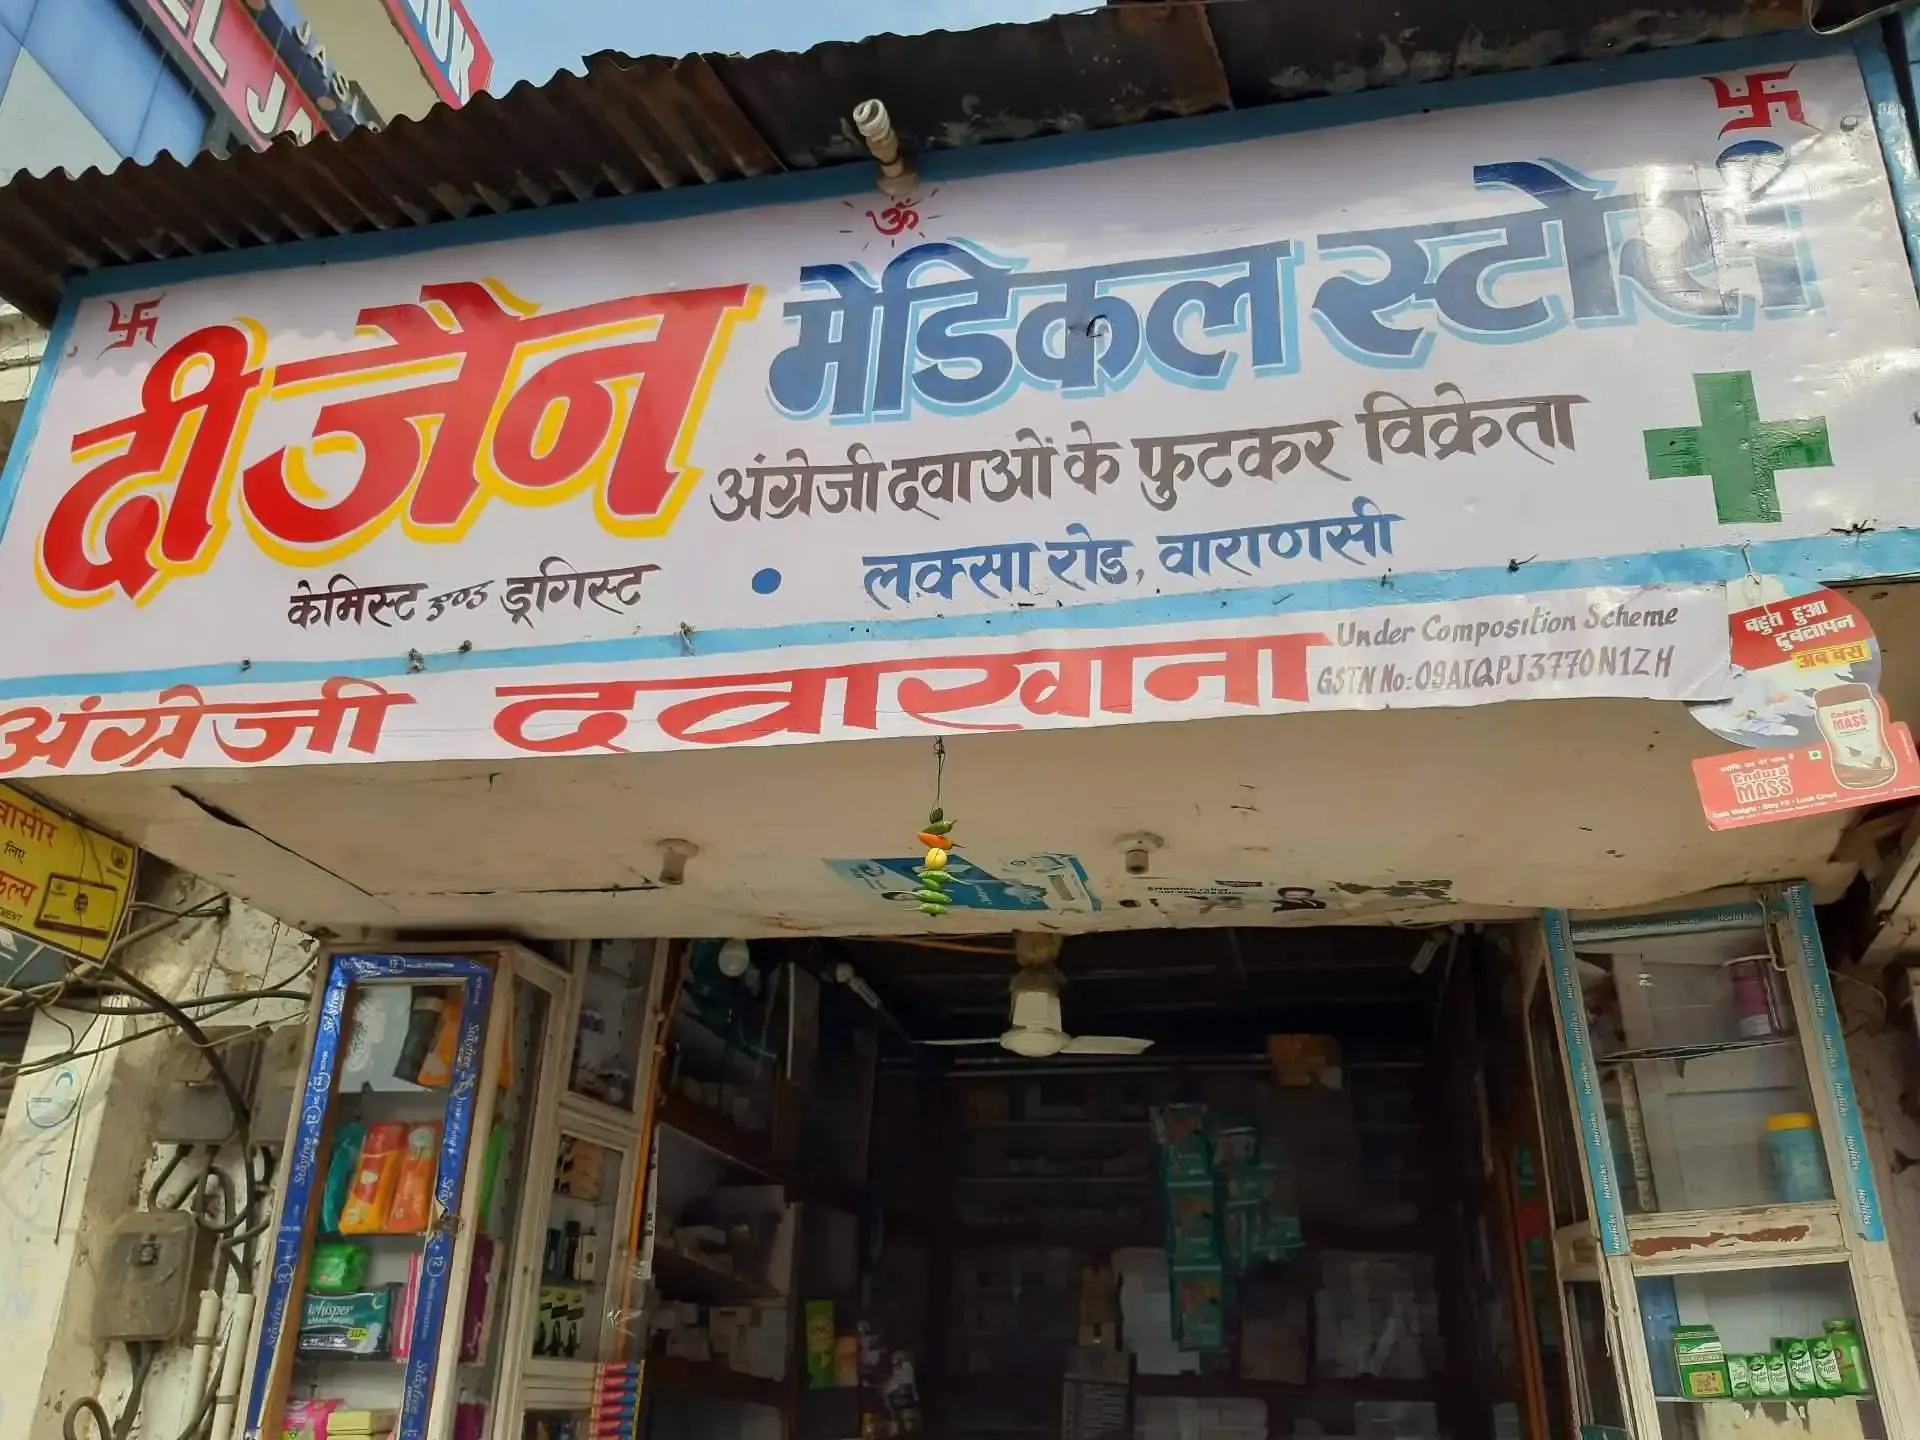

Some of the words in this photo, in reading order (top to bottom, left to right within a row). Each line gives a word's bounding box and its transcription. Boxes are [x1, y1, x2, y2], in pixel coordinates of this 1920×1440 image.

[402, 0, 475, 106] UK
[35, 316, 269, 608] दी
[242, 277, 765, 568] जैन
[767, 236, 1303, 426] मेडिकल
[710, 442, 887, 522] अंग्रेजी
[888, 427, 1061, 521] दवाओं
[1063, 420, 1121, 496] के
[1131, 419, 1353, 512] फुटकर
[1354, 381, 1591, 465] विक्रेता
[861, 542, 1042, 611] लक्सा
[1156, 495, 1406, 577] वाराणसी
[287, 573, 429, 630] केमिस्ट
[500, 556, 663, 630] ड्रगिस्ट
[1337, 618, 1416, 648] Under
[1421, 610, 1577, 648] Composition
[1583, 605, 1679, 630] Scheme
[1743, 610, 1784, 636] बहुत
[1790, 600, 1829, 626] हुआ
[0, 676, 418, 774] अंग्रेजी
[494, 631, 1332, 752] दवाखाना
[1731, 765, 1790, 785] Endura
[1735, 777, 1794, 803] MASS
[1833, 1082, 1849, 1118] Horlicks
[1845, 1134, 1862, 1172] Horlicks
[1603, 1162, 1615, 1200] Horlicks
[1857, 1188, 1874, 1227] Horlicks
[1612, 1212, 1624, 1250] Horlicks
[410, 1360, 429, 1416] Stayfree
